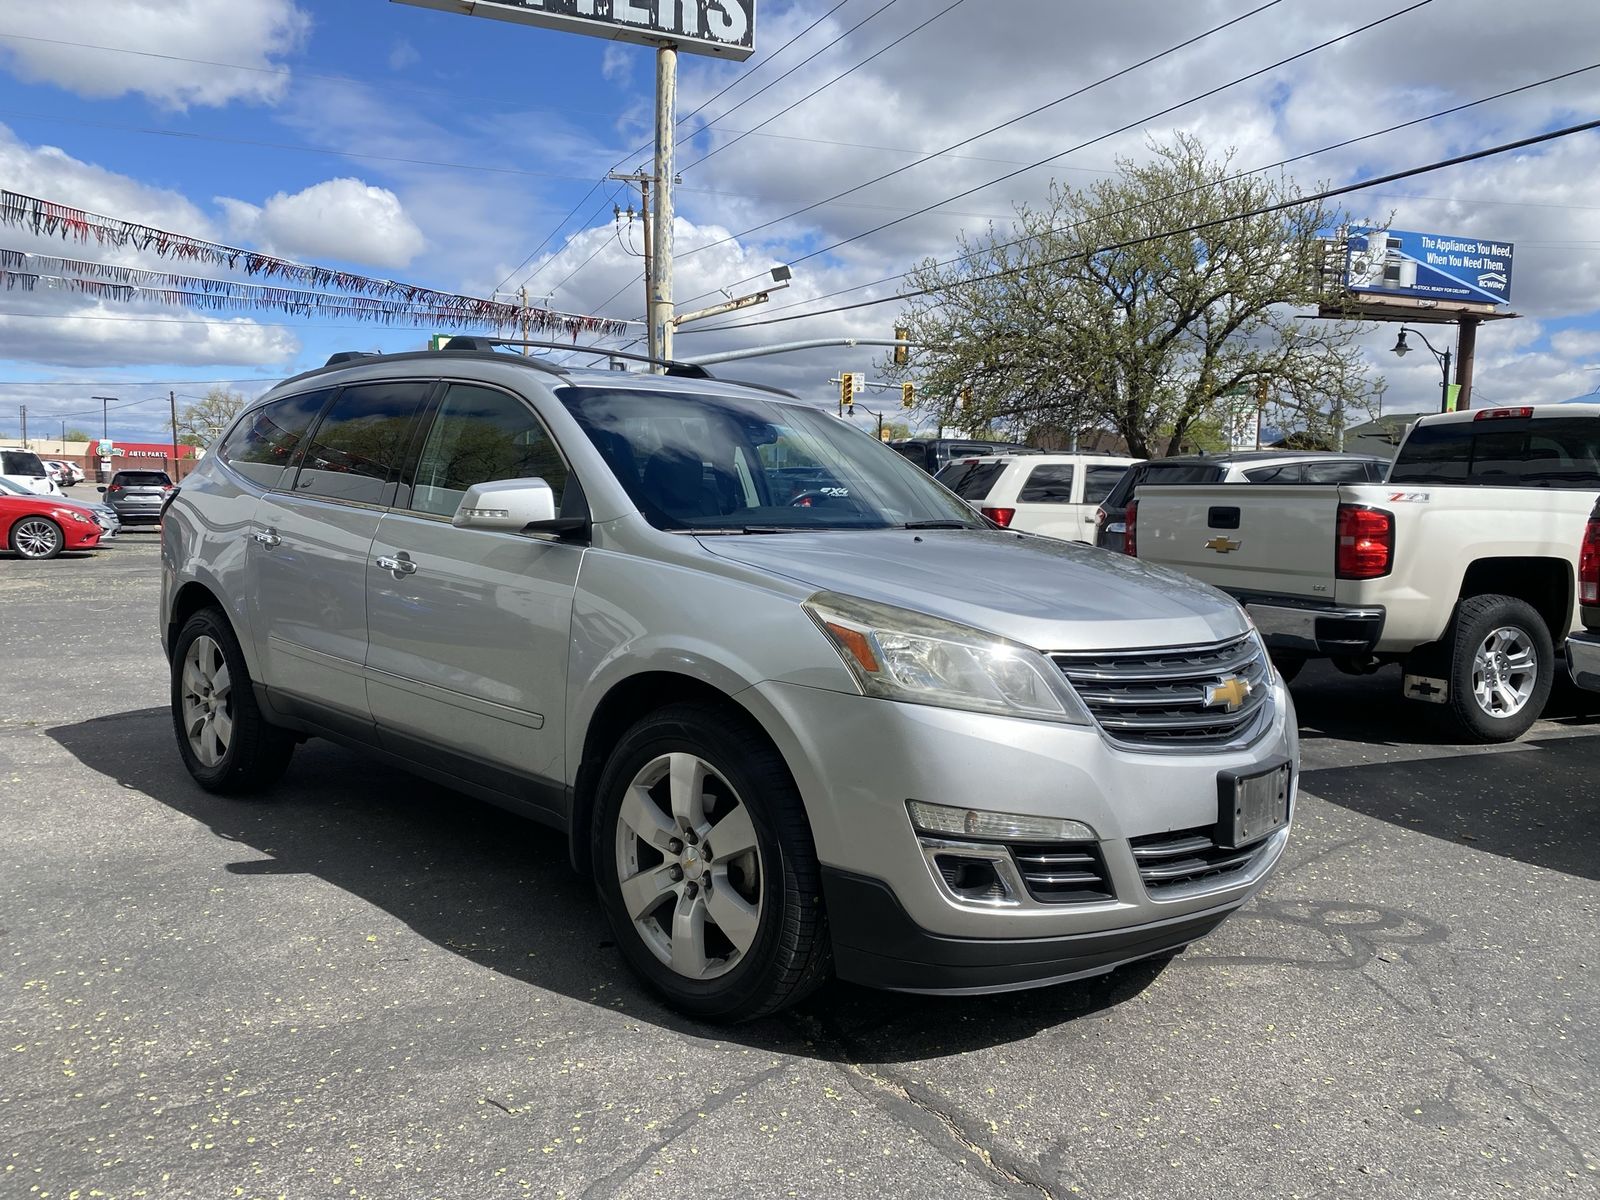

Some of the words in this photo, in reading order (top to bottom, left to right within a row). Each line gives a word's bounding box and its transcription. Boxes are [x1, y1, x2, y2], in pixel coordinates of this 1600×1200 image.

[1422, 237, 1435, 249] The
[1436, 239, 1476, 253] Appliances
[1477, 243, 1490, 255] You
[1491, 244, 1512, 259] Need,
[1427, 253, 1447, 265] When
[1449, 255, 1462, 266] You
[1463, 256, 1482, 269] Need
[1483, 258, 1505, 271] Them.
